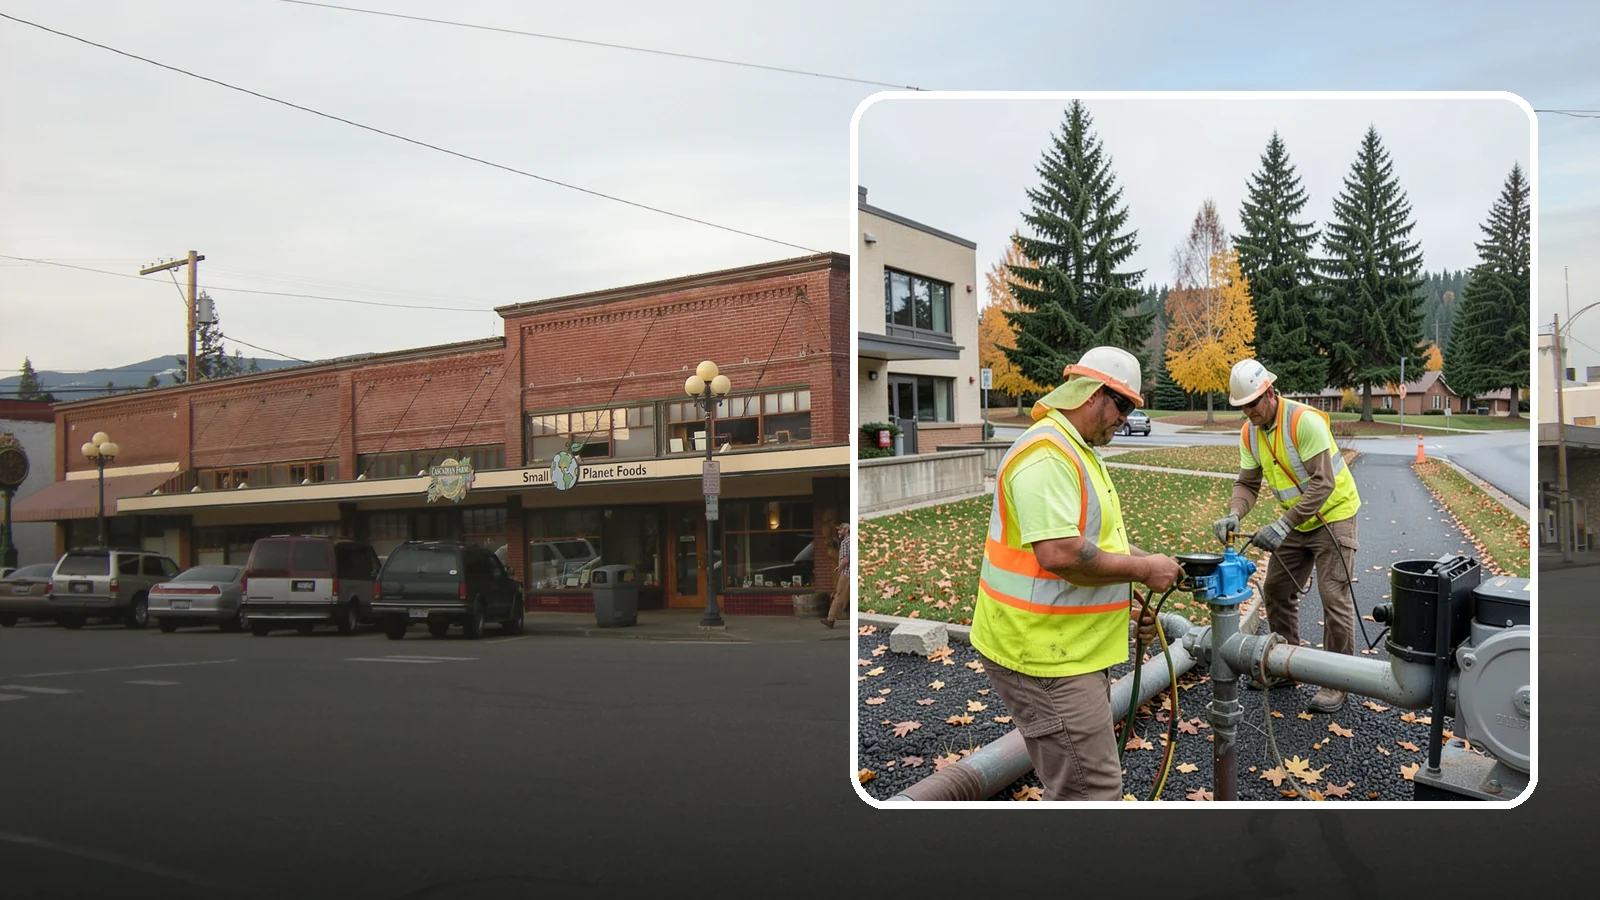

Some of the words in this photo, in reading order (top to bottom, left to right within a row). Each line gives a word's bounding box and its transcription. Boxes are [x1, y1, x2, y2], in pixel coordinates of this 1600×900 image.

[431, 466, 456, 476] CASCADIAN
[523, 471, 548, 482] Small
[583, 467, 614, 479] Planet
[617, 464, 647, 476] Foods
